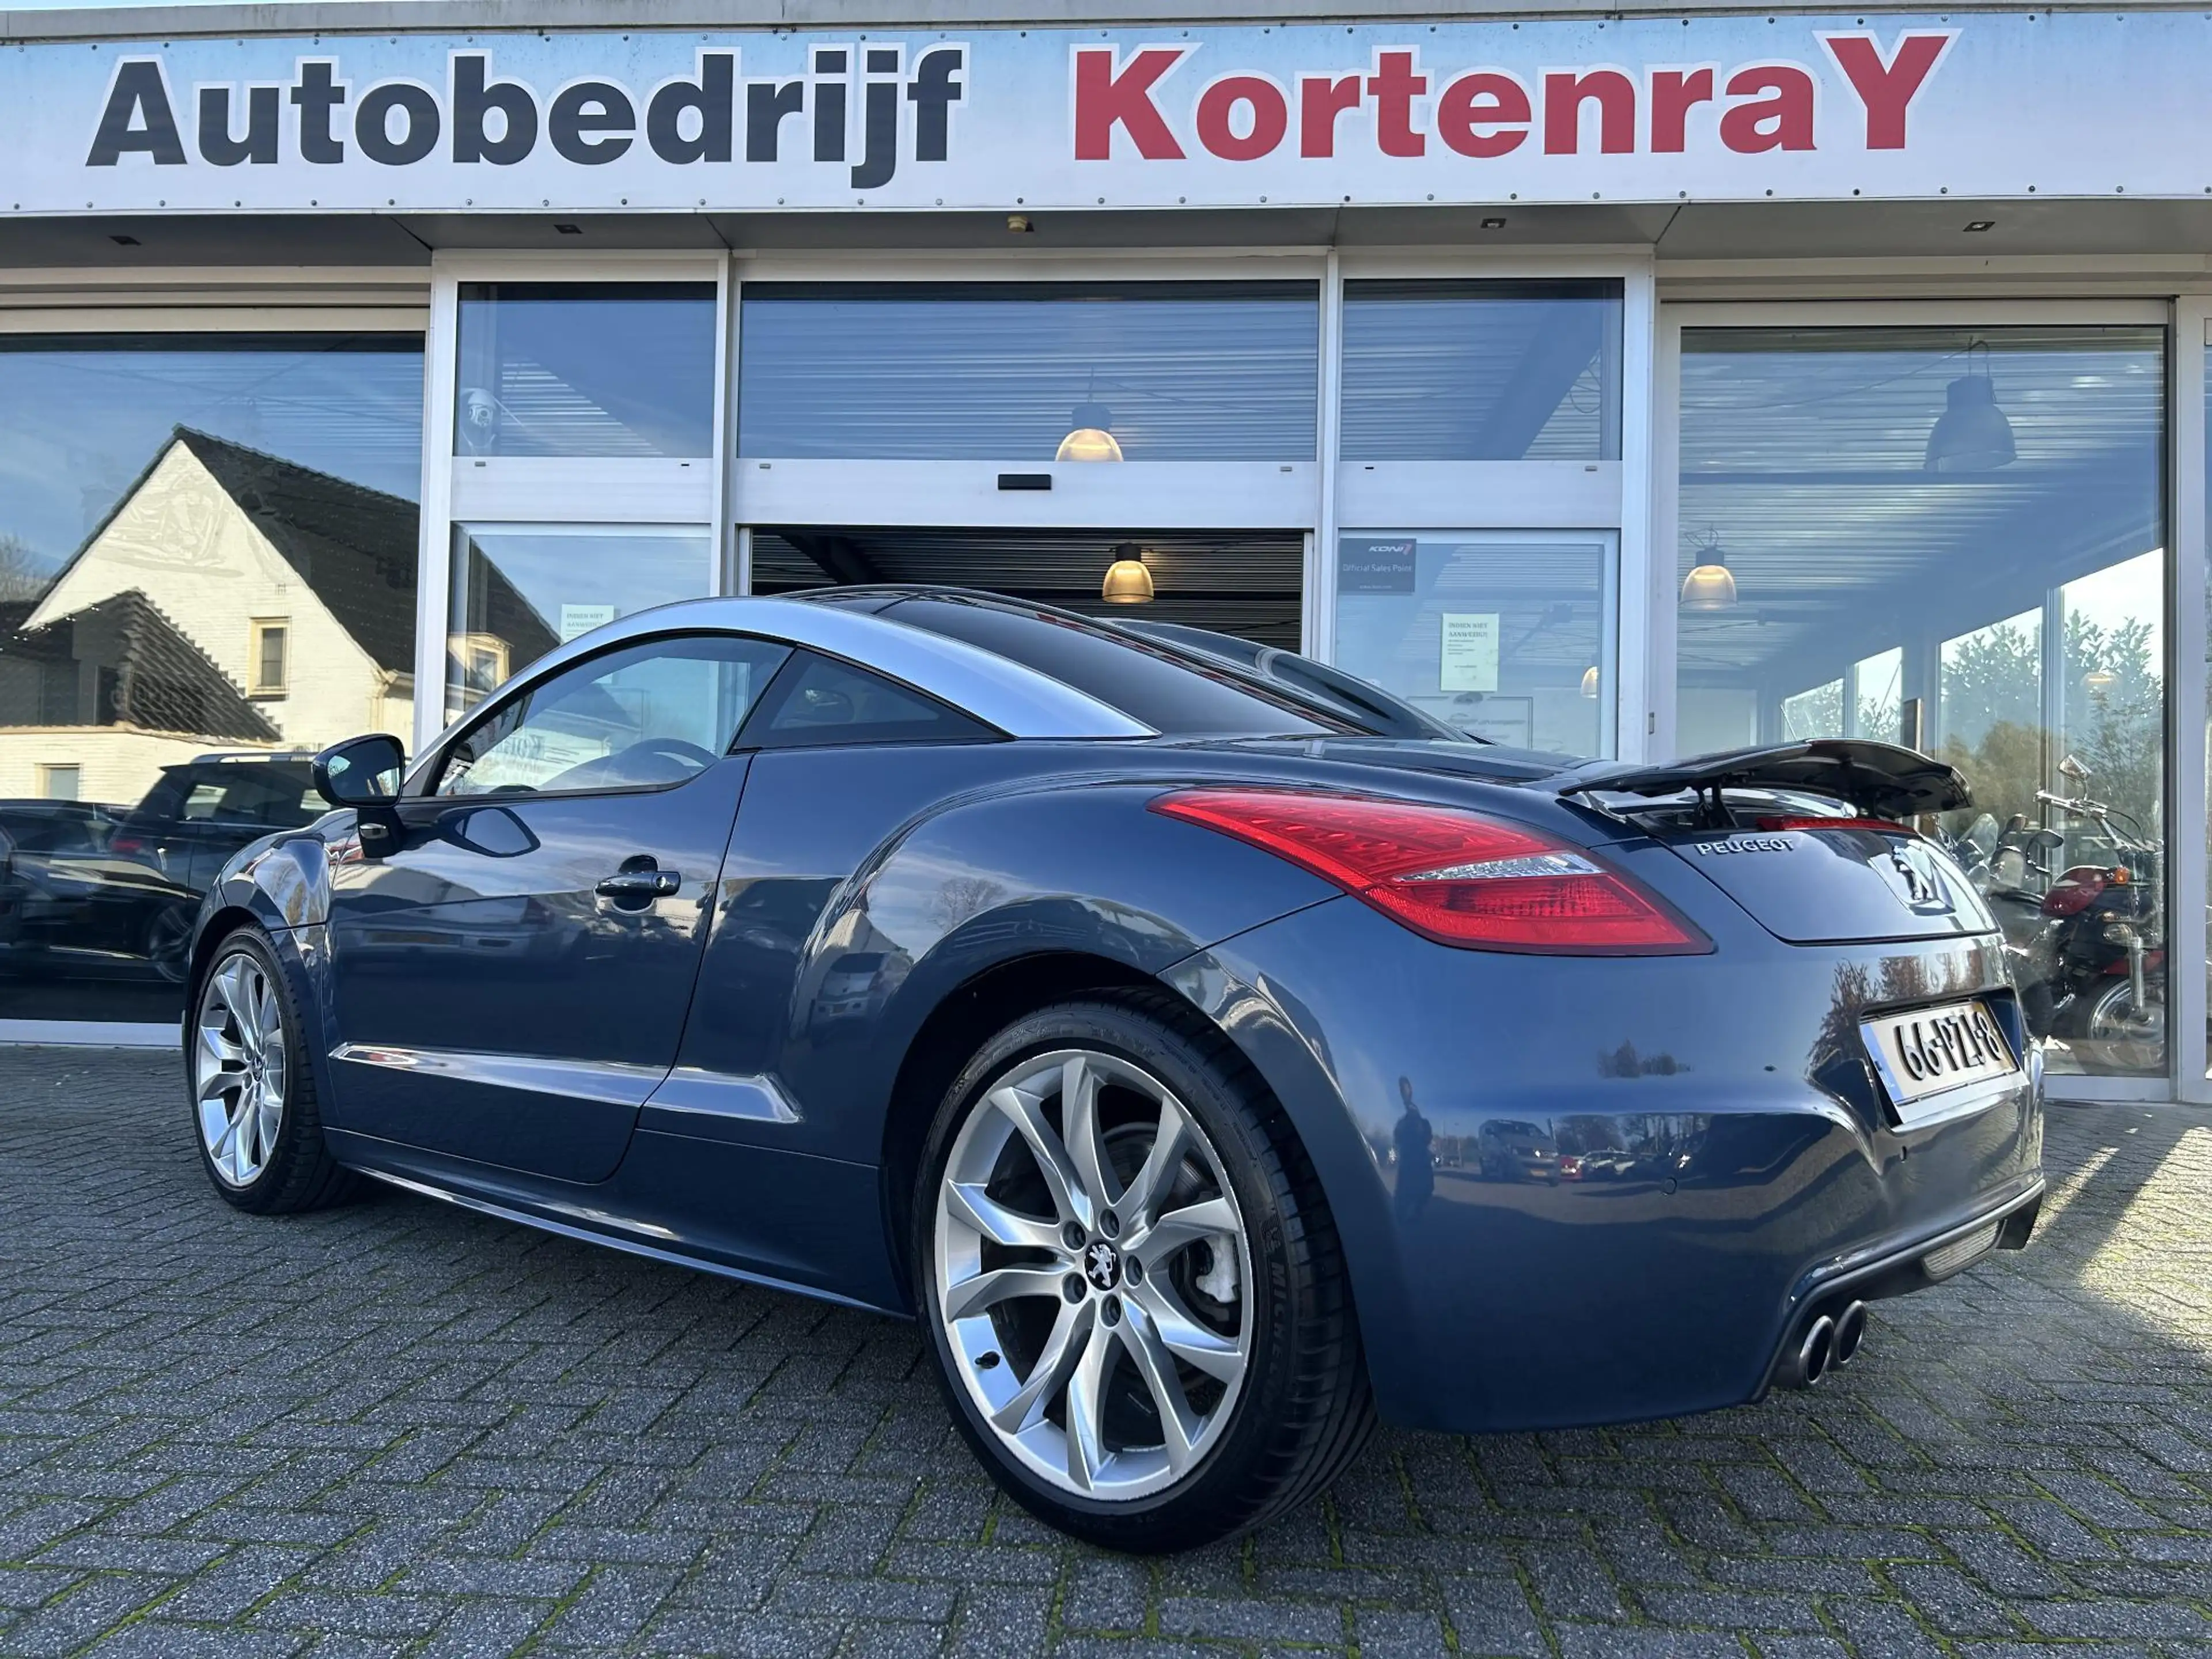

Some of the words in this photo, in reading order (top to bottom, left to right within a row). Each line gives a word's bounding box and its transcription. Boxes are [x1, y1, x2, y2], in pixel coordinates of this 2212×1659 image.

[87, 50, 963, 189] Autobedrijf
[1075, 37, 1944, 161] KortenraY
[1371, 563, 1391, 572] Sales
[1393, 564, 1412, 572] Point
[1694, 839, 1794, 856] PEUGEOT
[1262, 1261, 1287, 1406] MICHEL
